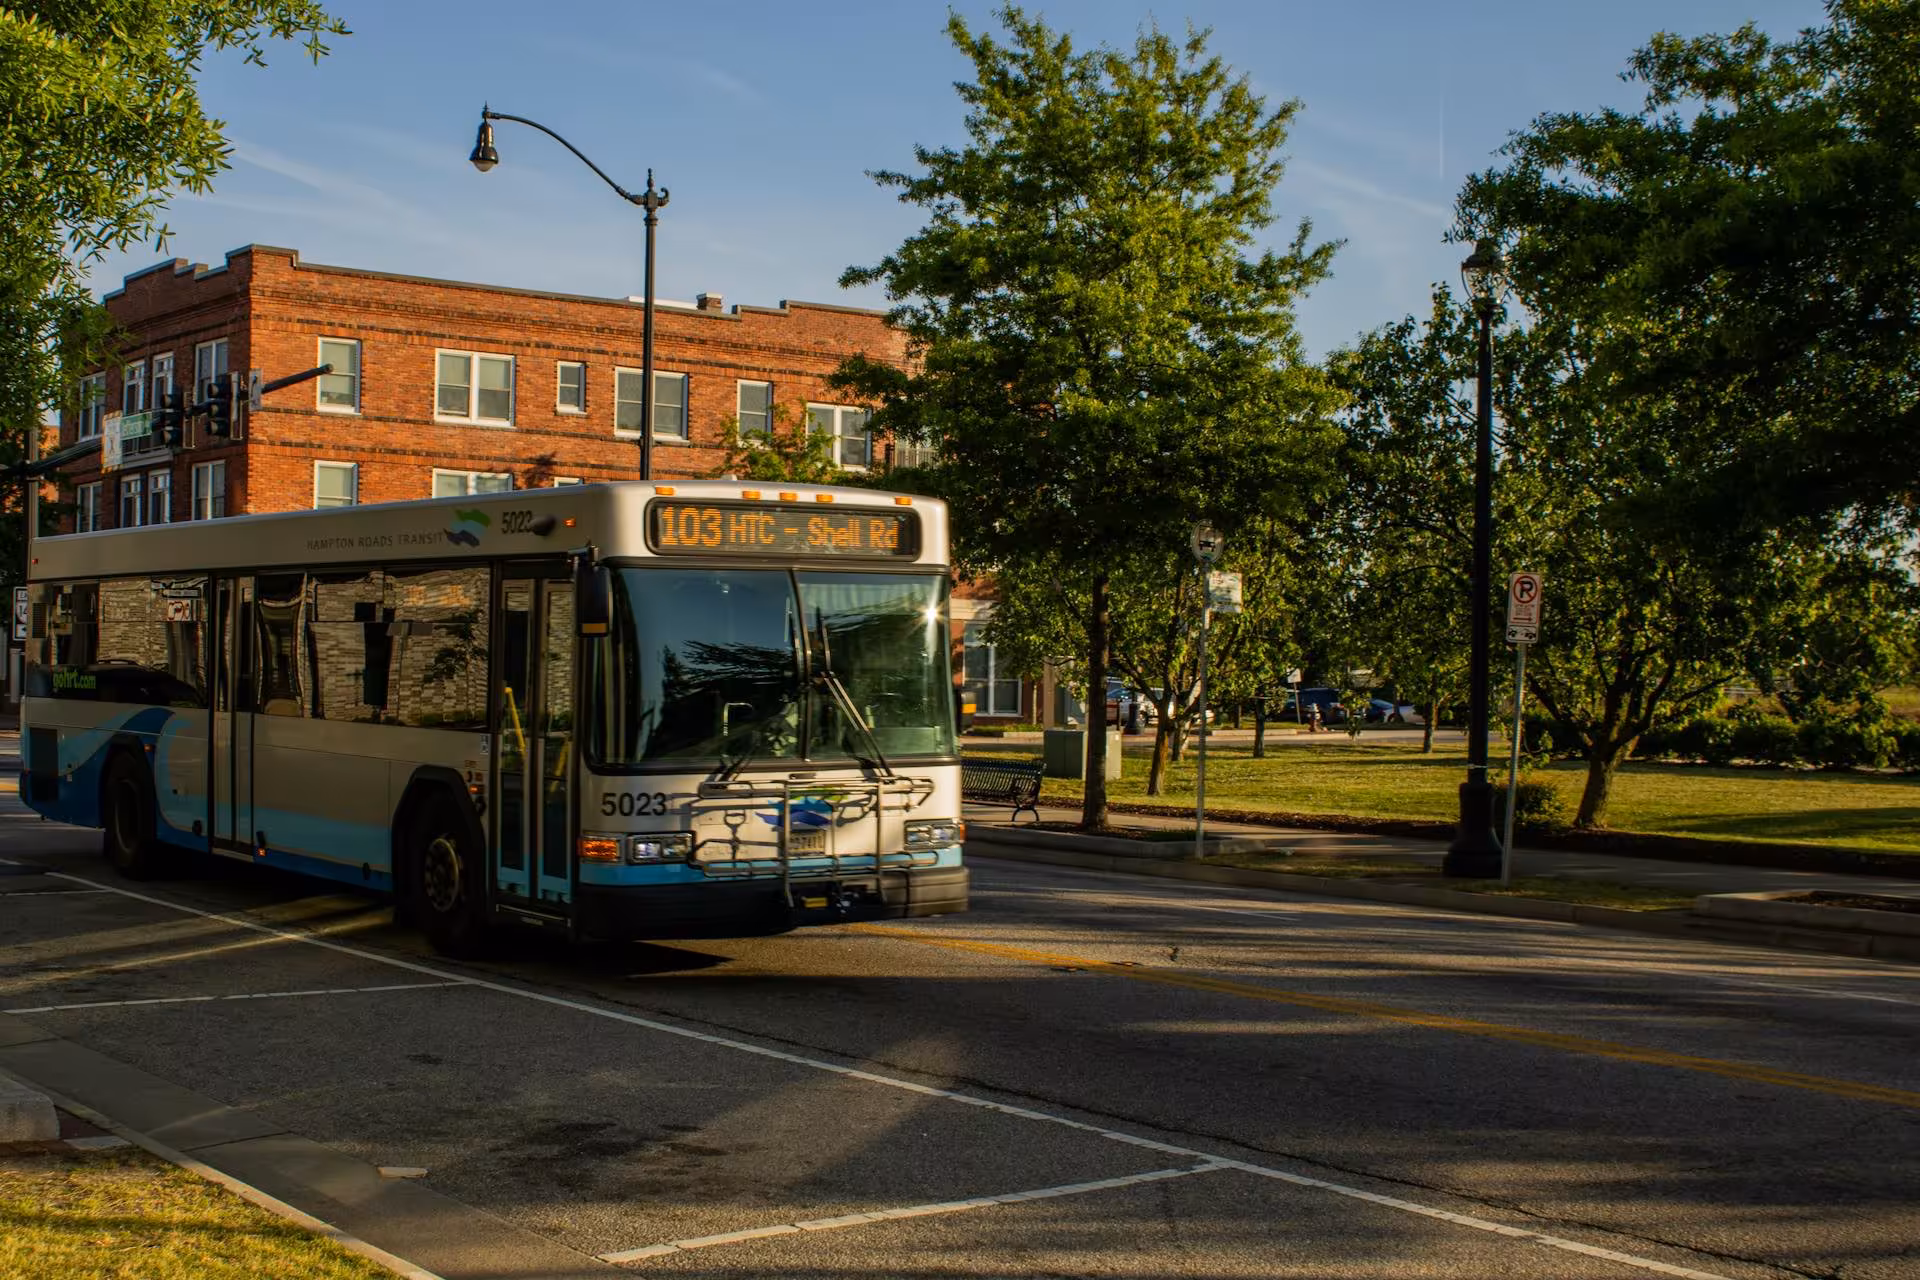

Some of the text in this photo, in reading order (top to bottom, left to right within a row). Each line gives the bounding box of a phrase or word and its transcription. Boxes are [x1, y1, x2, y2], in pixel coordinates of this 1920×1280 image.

[661, 506, 722, 547] 103
[730, 512, 776, 545] HTC
[807, 515, 861, 548] Shell
[869, 519, 899, 549] Rd
[307, 531, 443, 550] HAMPTON ROADS TRANSIT
[53, 671, 97, 690] gohrt.com
[601, 792, 667, 817] 5023
